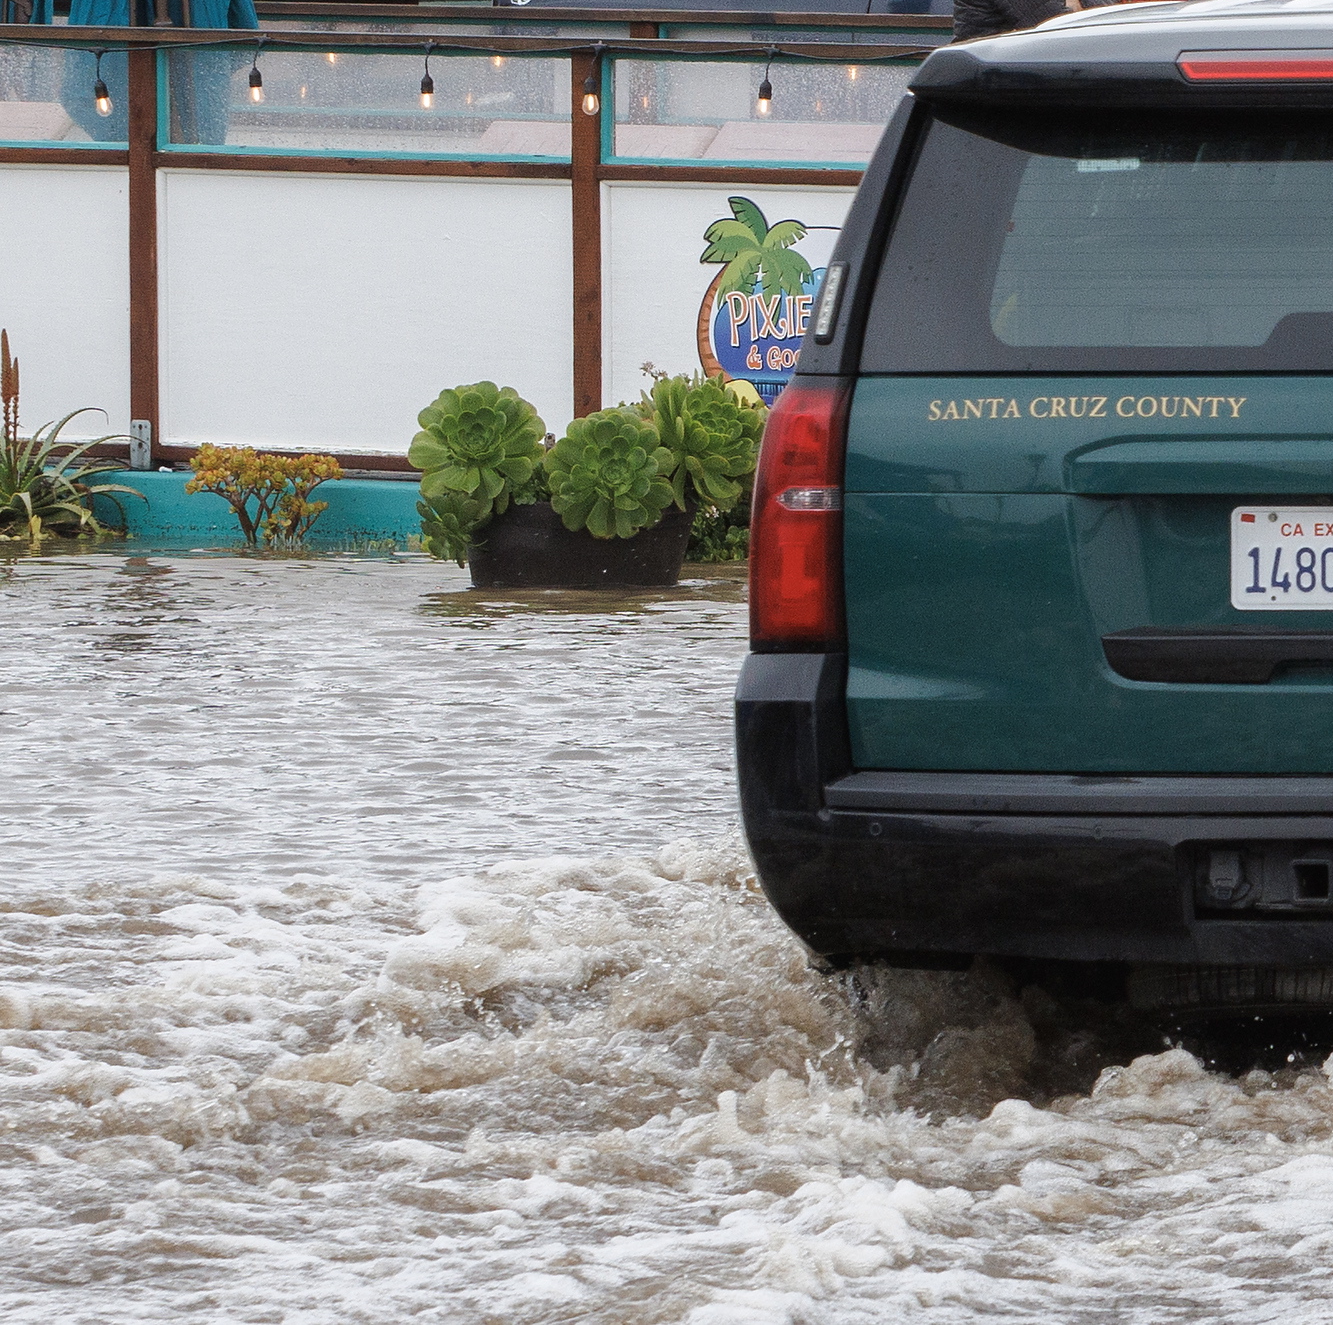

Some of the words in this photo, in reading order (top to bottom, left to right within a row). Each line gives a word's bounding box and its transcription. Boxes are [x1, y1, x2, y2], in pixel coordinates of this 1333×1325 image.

[725, 291, 815, 347] PIXIE
[746, 345, 763, 370] &
[928, 398, 1021, 421] SANTA
[1029, 396, 1108, 419] CRUZ
[1115, 396, 1247, 418] COUNTY
[1280, 523, 1304, 536] CA
